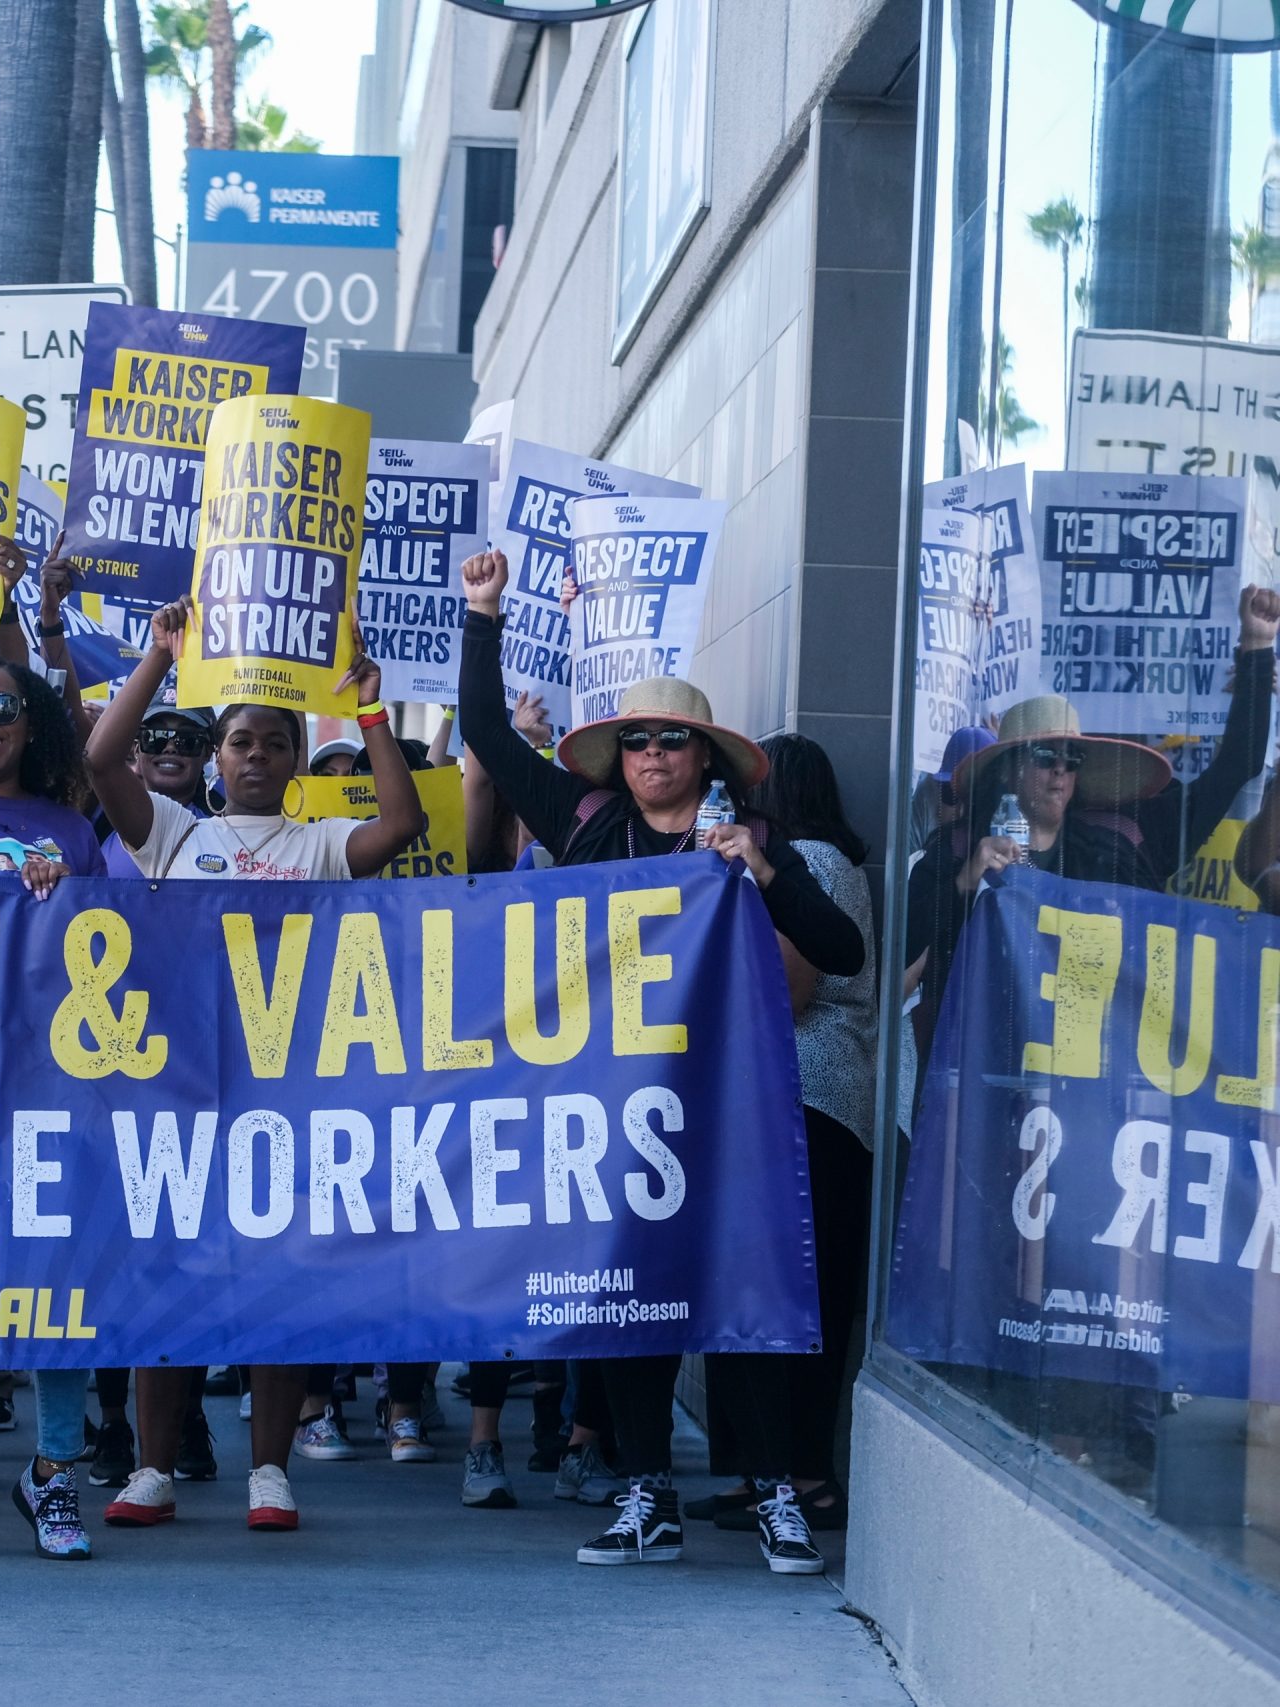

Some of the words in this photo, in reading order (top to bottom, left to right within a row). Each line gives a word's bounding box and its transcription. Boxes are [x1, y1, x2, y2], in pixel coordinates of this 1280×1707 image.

[269, 187, 326, 205] KAISER
[269, 208, 381, 228] PERMANENTE
[201, 268, 380, 326] 4700
[178, 323, 203, 334] SEIU-
[183, 331, 209, 342] UHW
[22, 328, 86, 360] LAN
[128, 357, 253, 399] KAISER
[102, 396, 209, 446] WORK
[259, 407, 292, 419] SEIU-
[265, 417, 300, 430] UHW
[378, 448, 407, 459] SEIU-
[385, 457, 413, 468] UHW
[221, 441, 343, 499] KAISER
[583, 467, 609, 482] SEIU-
[587, 477, 616, 493] UHW
[364, 479, 469, 526] SPECT
[614, 505, 640, 516] SEIU-
[85, 495, 201, 551] SILENC
[206, 491, 356, 553] WORKERS
[379, 525, 407, 537] AND
[619, 514, 646, 524] UHW
[96, 558, 140, 579] STRIKE
[358, 538, 443, 583] ALUE
[574, 535, 698, 587] RESPECT
[210, 549, 253, 601] ON
[266, 547, 335, 604] ULP
[607, 581, 629, 593] AND
[208, 601, 329, 661] STRIKE
[585, 594, 662, 644] VALUE
[363, 627, 451, 664] RKERS
[500, 635, 571, 688] WORK
[576, 647, 681, 696] HEALTHCARE
[233, 667, 293, 686] #UNITED4ALL
[220, 686, 306, 703] #SOLIDARITYSEASON
[412, 686, 459, 696] #SOLIDARITYSEA
[583, 688, 628, 724] WORK
[342, 786, 371, 797] SEIU-
[49, 908, 168, 1080] &
[221, 886, 689, 1079] VALUE
[112, 1086, 687, 1240] WORKERS
[526, 1268, 634, 1296] #United4All
[526, 1299, 689, 1328] #SolidaritySeason
